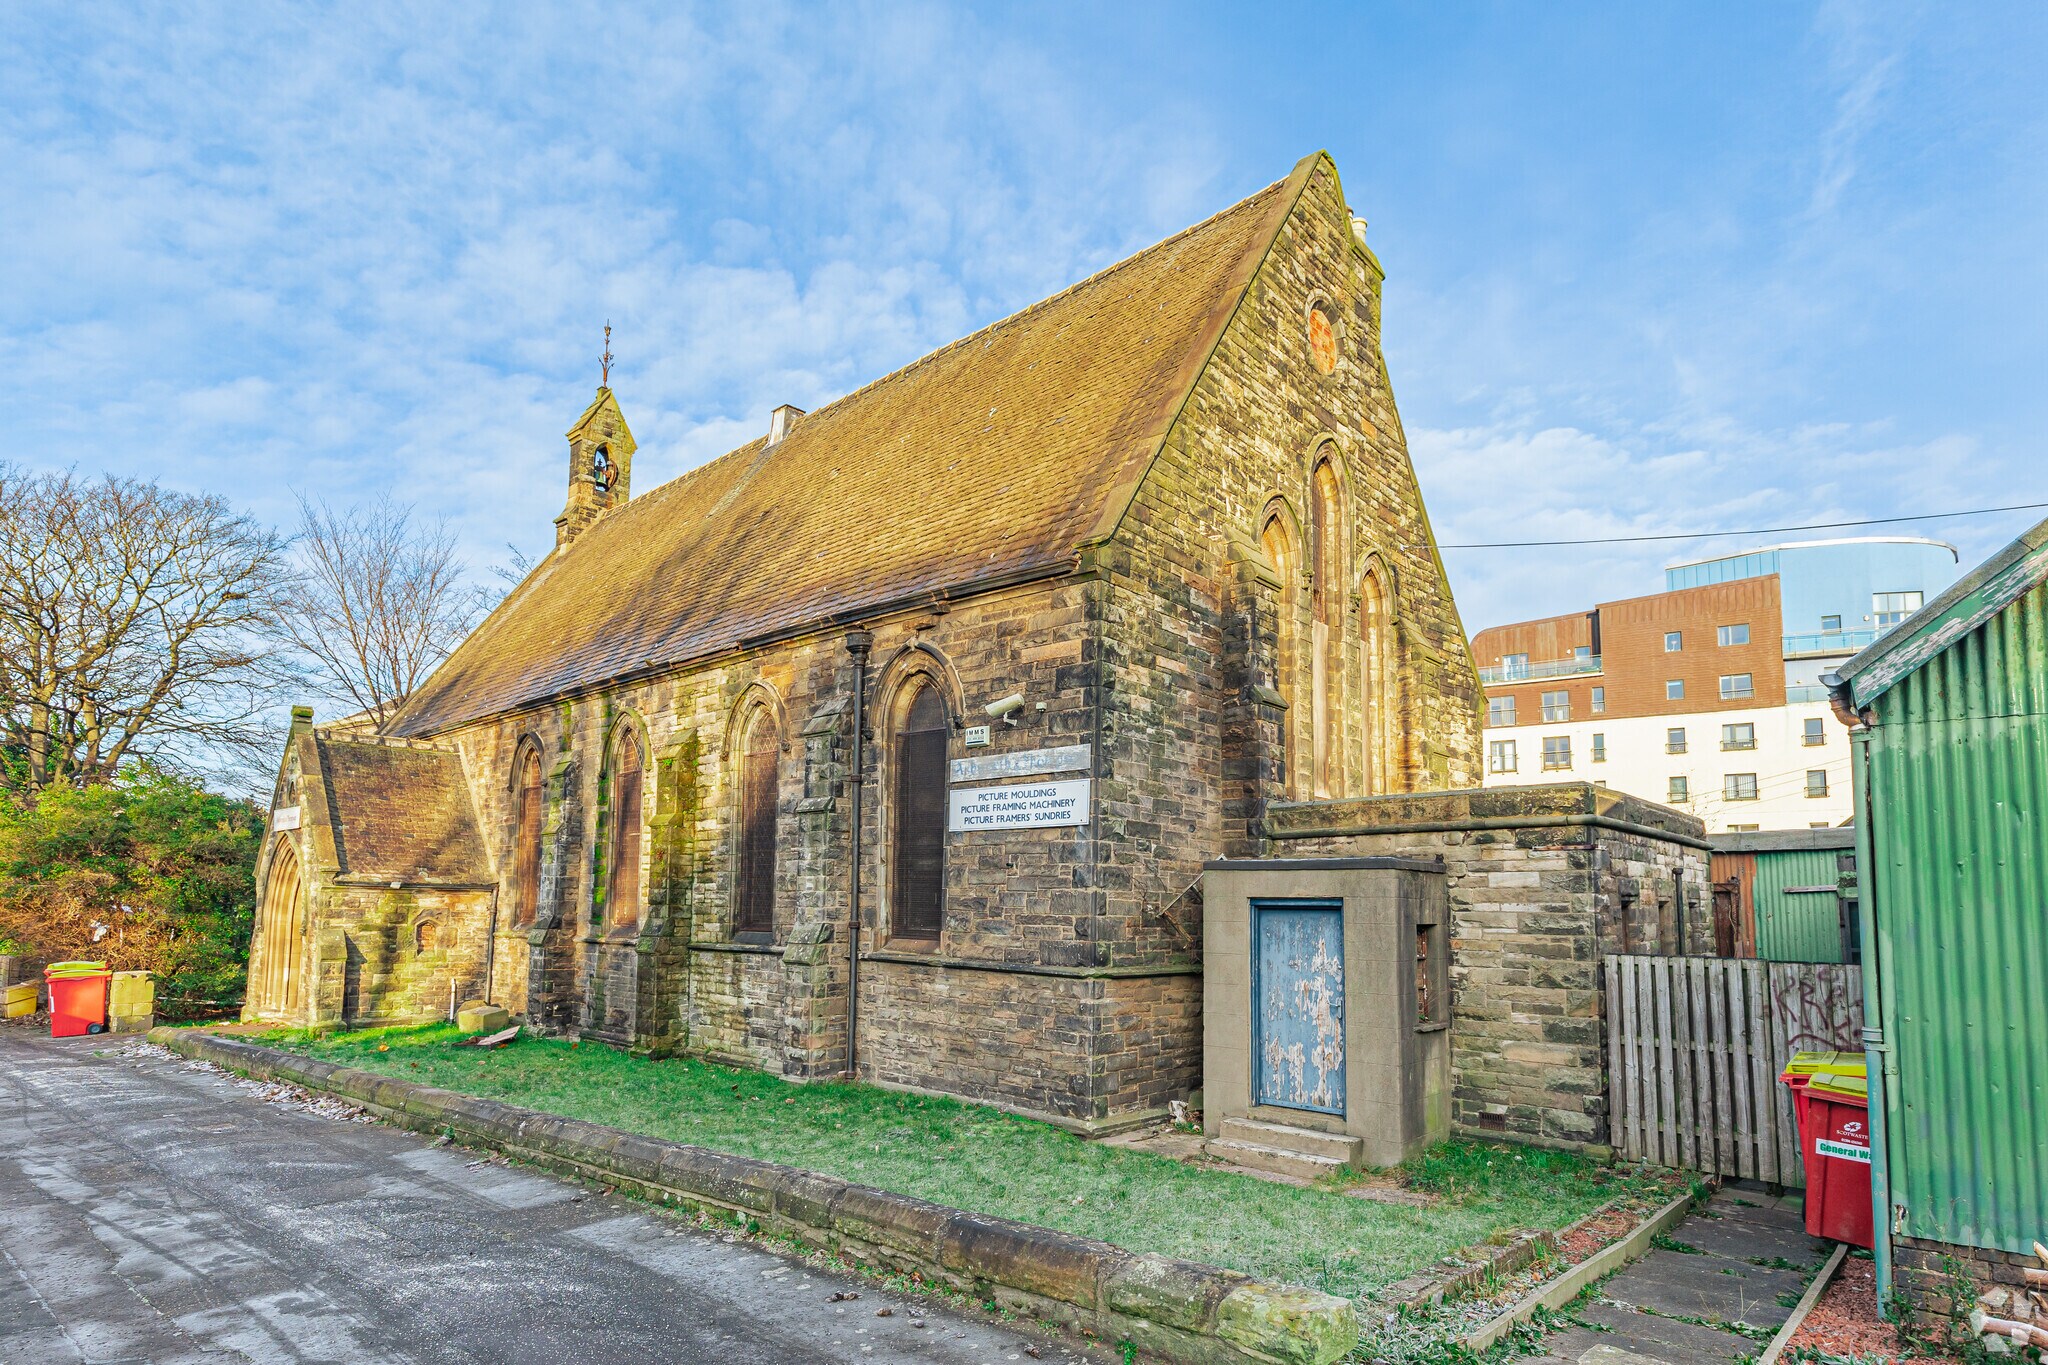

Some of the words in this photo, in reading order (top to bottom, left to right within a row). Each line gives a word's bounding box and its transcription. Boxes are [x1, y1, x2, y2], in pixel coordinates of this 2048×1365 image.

[978, 792, 1009, 801] PICTURE
[1011, 788, 1057, 799] MOULDINGS
[961, 804, 990, 814] PICTURE
[993, 802, 1027, 811] FRAMING
[1029, 798, 1076, 809] MACHINERY
[964, 815, 994, 825] PICTURE
[1035, 810, 1071, 821] SUNDRIES
[1836, 1130, 1869, 1140] SCOTWASTE
[1820, 1143, 1857, 1157] General
